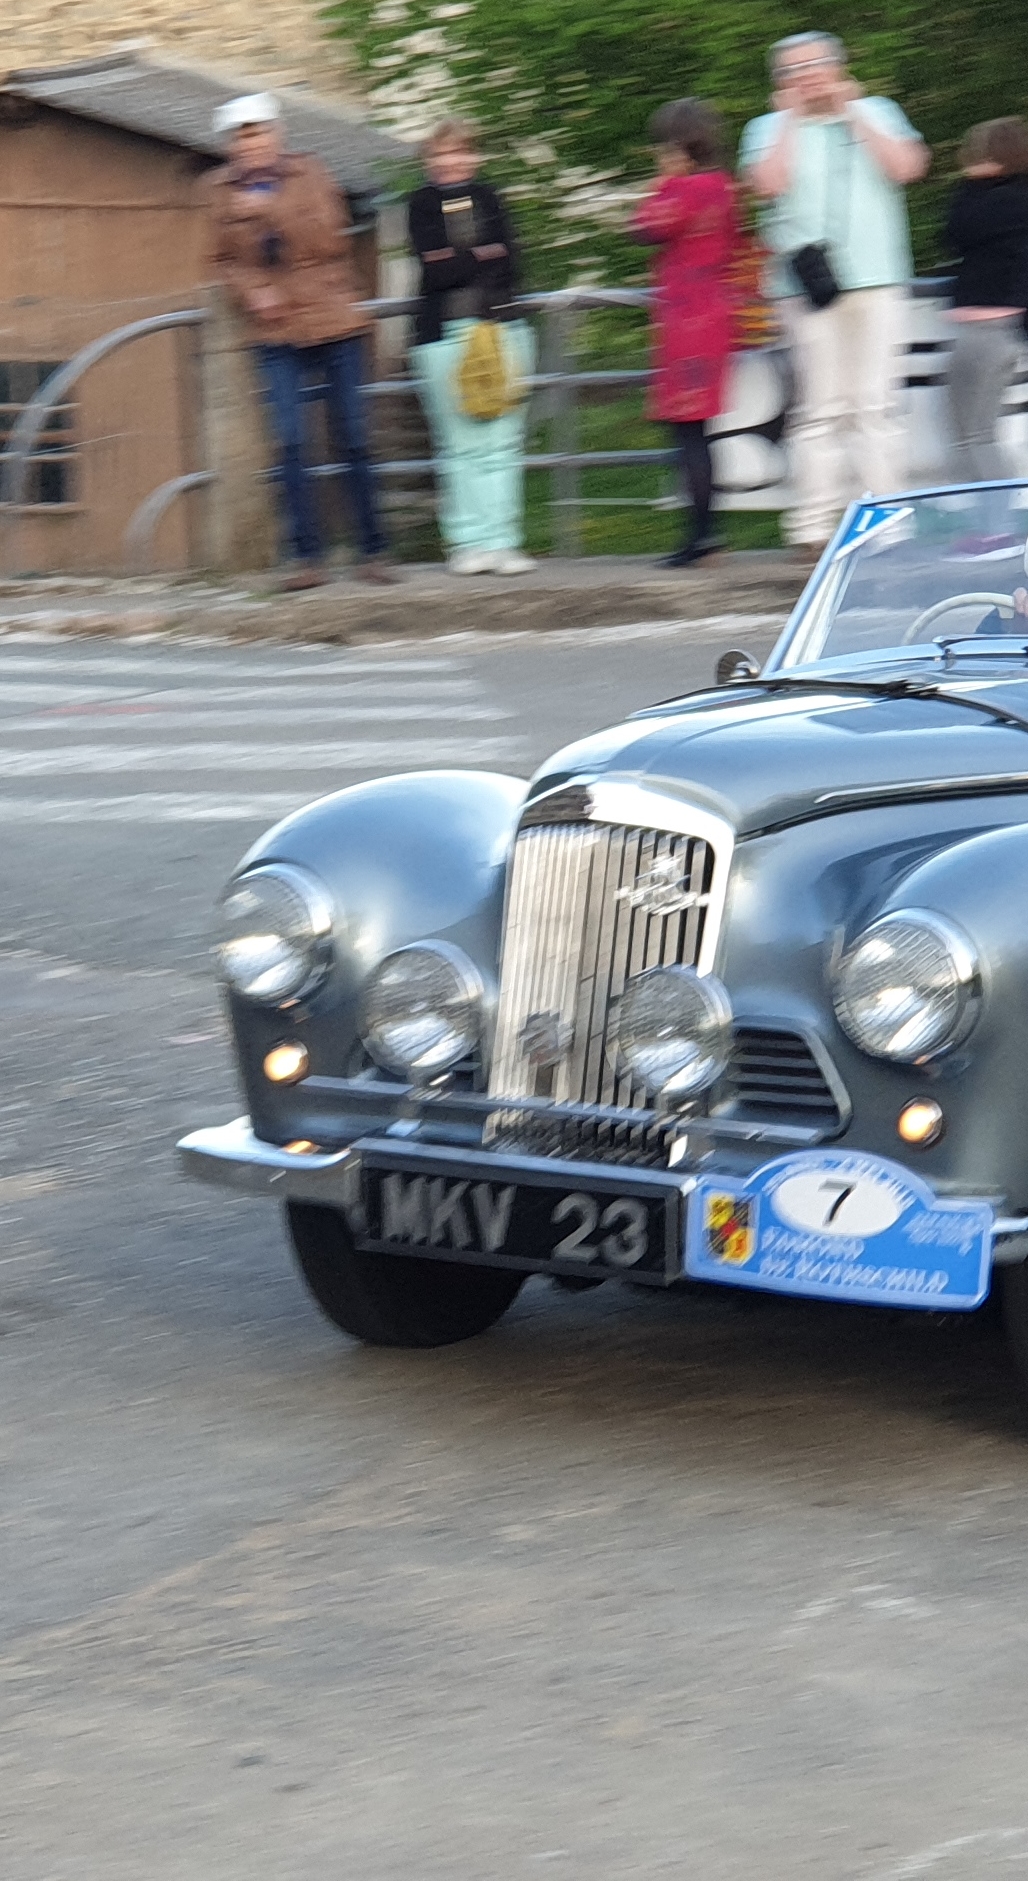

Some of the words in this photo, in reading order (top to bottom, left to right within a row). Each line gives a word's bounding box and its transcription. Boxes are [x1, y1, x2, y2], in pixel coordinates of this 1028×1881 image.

[380, 1173, 518, 1252] MKV
[551, 1192, 649, 1268] 23
[817, 1176, 858, 1228] 7
